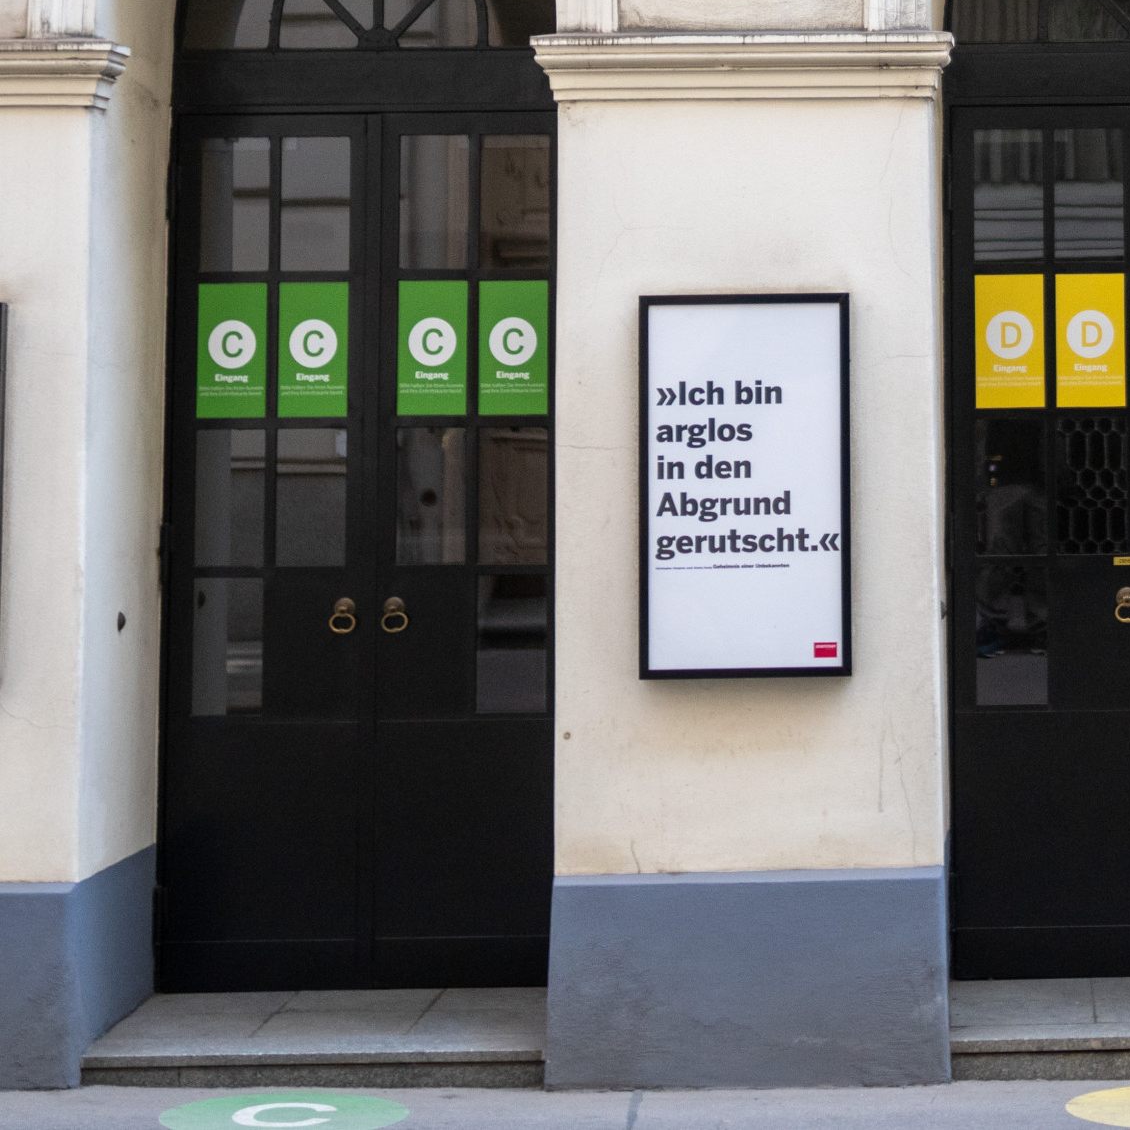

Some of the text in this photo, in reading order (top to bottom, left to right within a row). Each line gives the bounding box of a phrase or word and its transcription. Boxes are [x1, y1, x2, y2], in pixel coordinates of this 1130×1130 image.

[221, 330, 243, 358] C
[302, 329, 325, 358] C
[421, 327, 444, 356] C
[502, 327, 525, 355] C
[1000, 321, 1022, 349] D
[1081, 320, 1103, 348] D
[215, 374, 248, 383] Eingang
[296, 373, 329, 382] Eingang
[415, 371, 448, 380] Eingang
[496, 371, 529, 380] Eingang
[993, 364, 1027, 373] Eingang
[1074, 363, 1108, 372] Eingang
[656, 380, 783, 406] »Ich bin
[656, 418, 753, 449] arglos
[657, 455, 752, 480] in den
[656, 491, 791, 523] Abgrund
[655, 527, 840, 561] gerutscht.«
[231, 1102, 338, 1127] C
